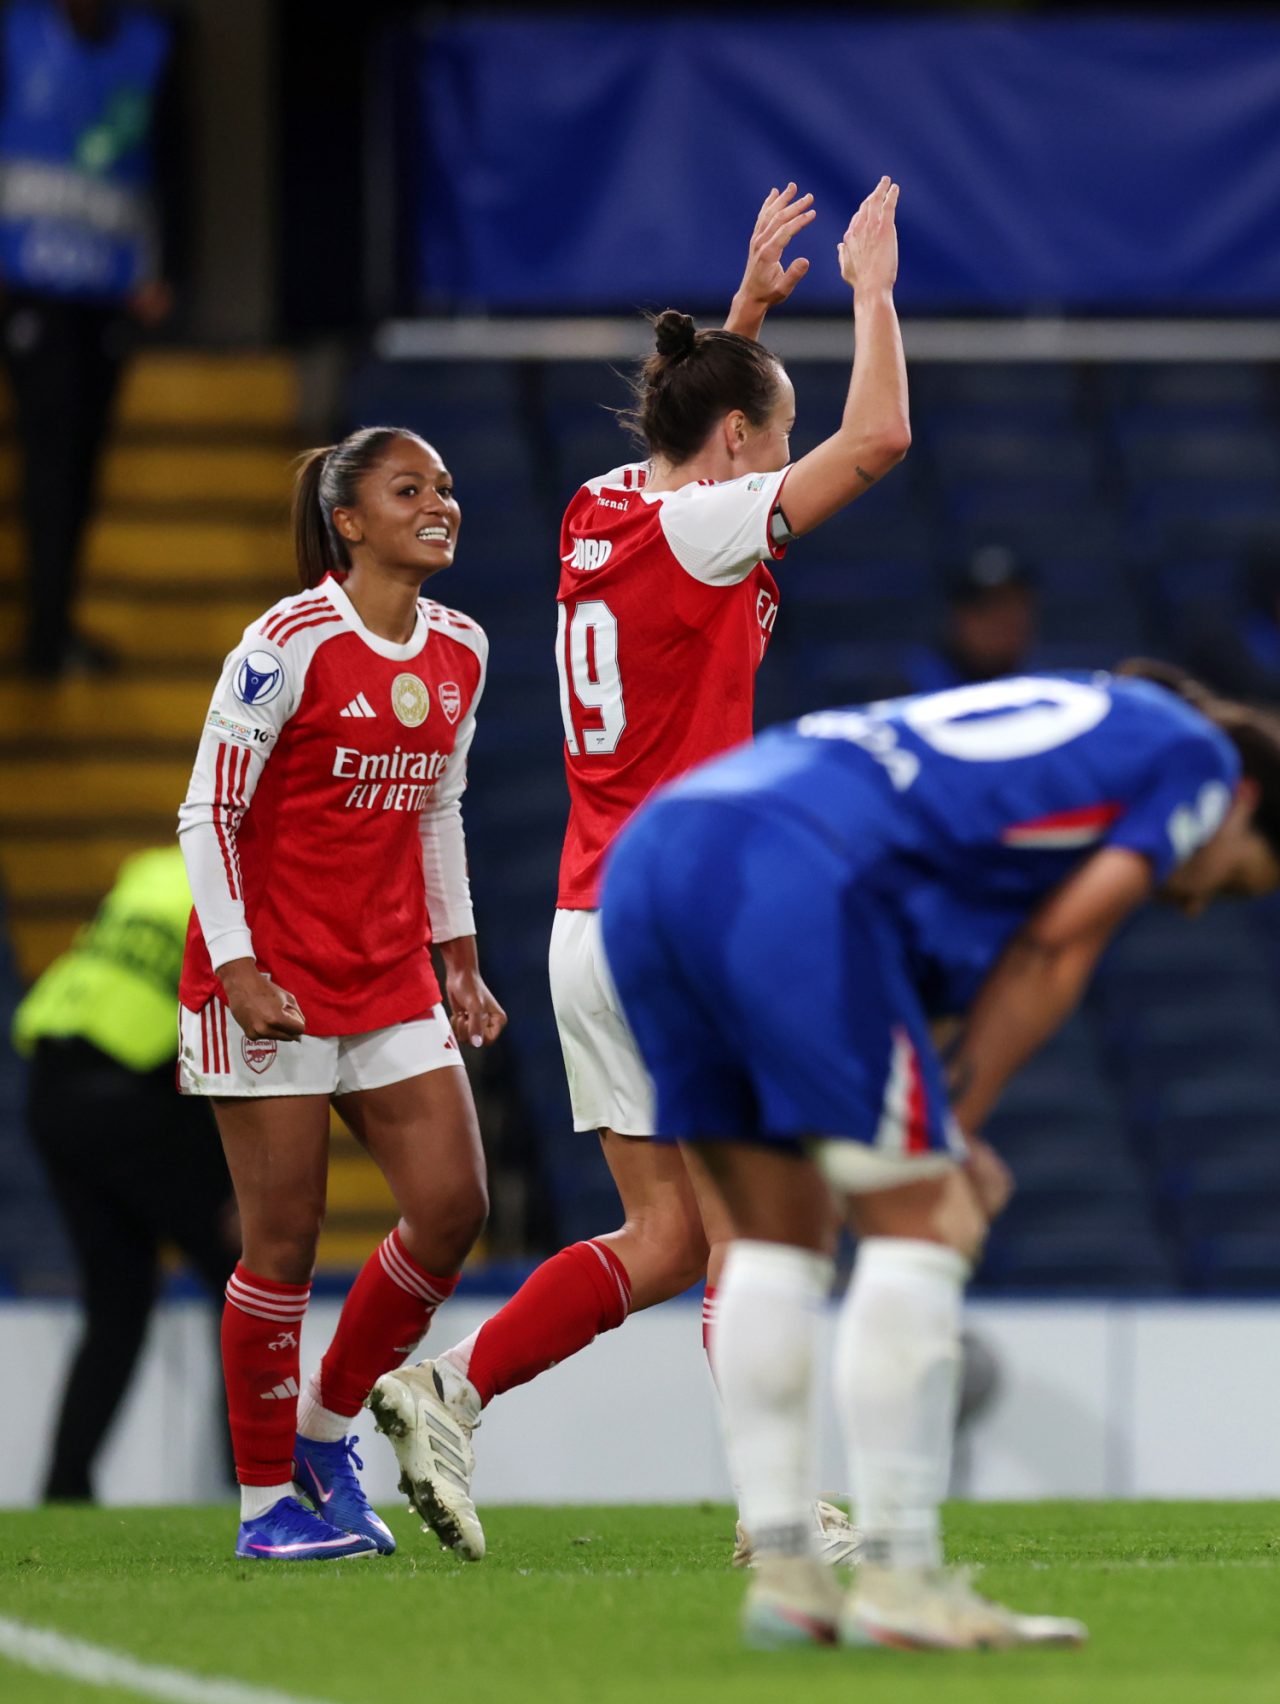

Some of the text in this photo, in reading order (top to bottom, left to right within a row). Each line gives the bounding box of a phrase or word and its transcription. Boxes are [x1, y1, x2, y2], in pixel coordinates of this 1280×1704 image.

[597, 497, 629, 511] rsenal
[554, 600, 628, 755] 19
[332, 745, 449, 780] Emirate
[345, 783, 433, 812] FLY BETTE
